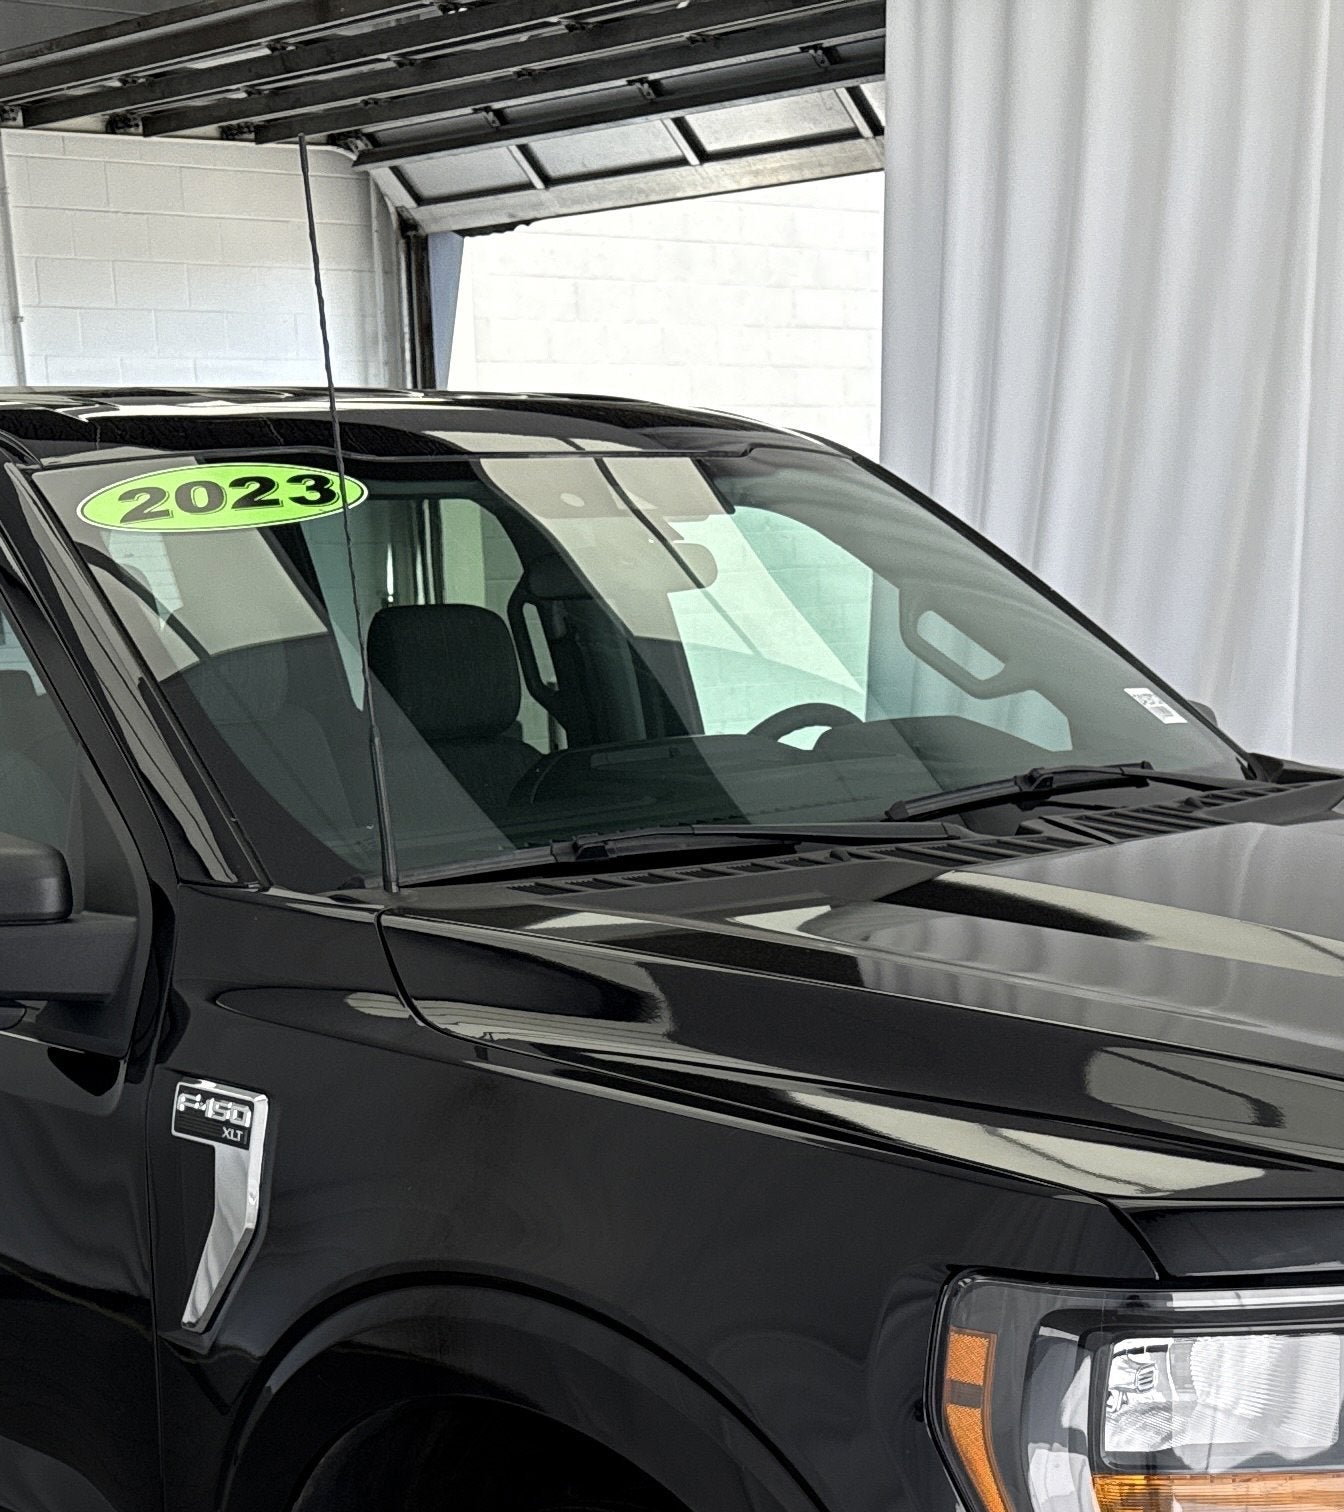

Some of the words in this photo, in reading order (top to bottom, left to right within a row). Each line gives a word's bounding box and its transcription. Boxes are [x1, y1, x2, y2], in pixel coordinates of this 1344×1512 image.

[118, 474, 341, 524] 2023
[177, 1093, 252, 1127] F-150
[222, 1127, 244, 1142] XLT
